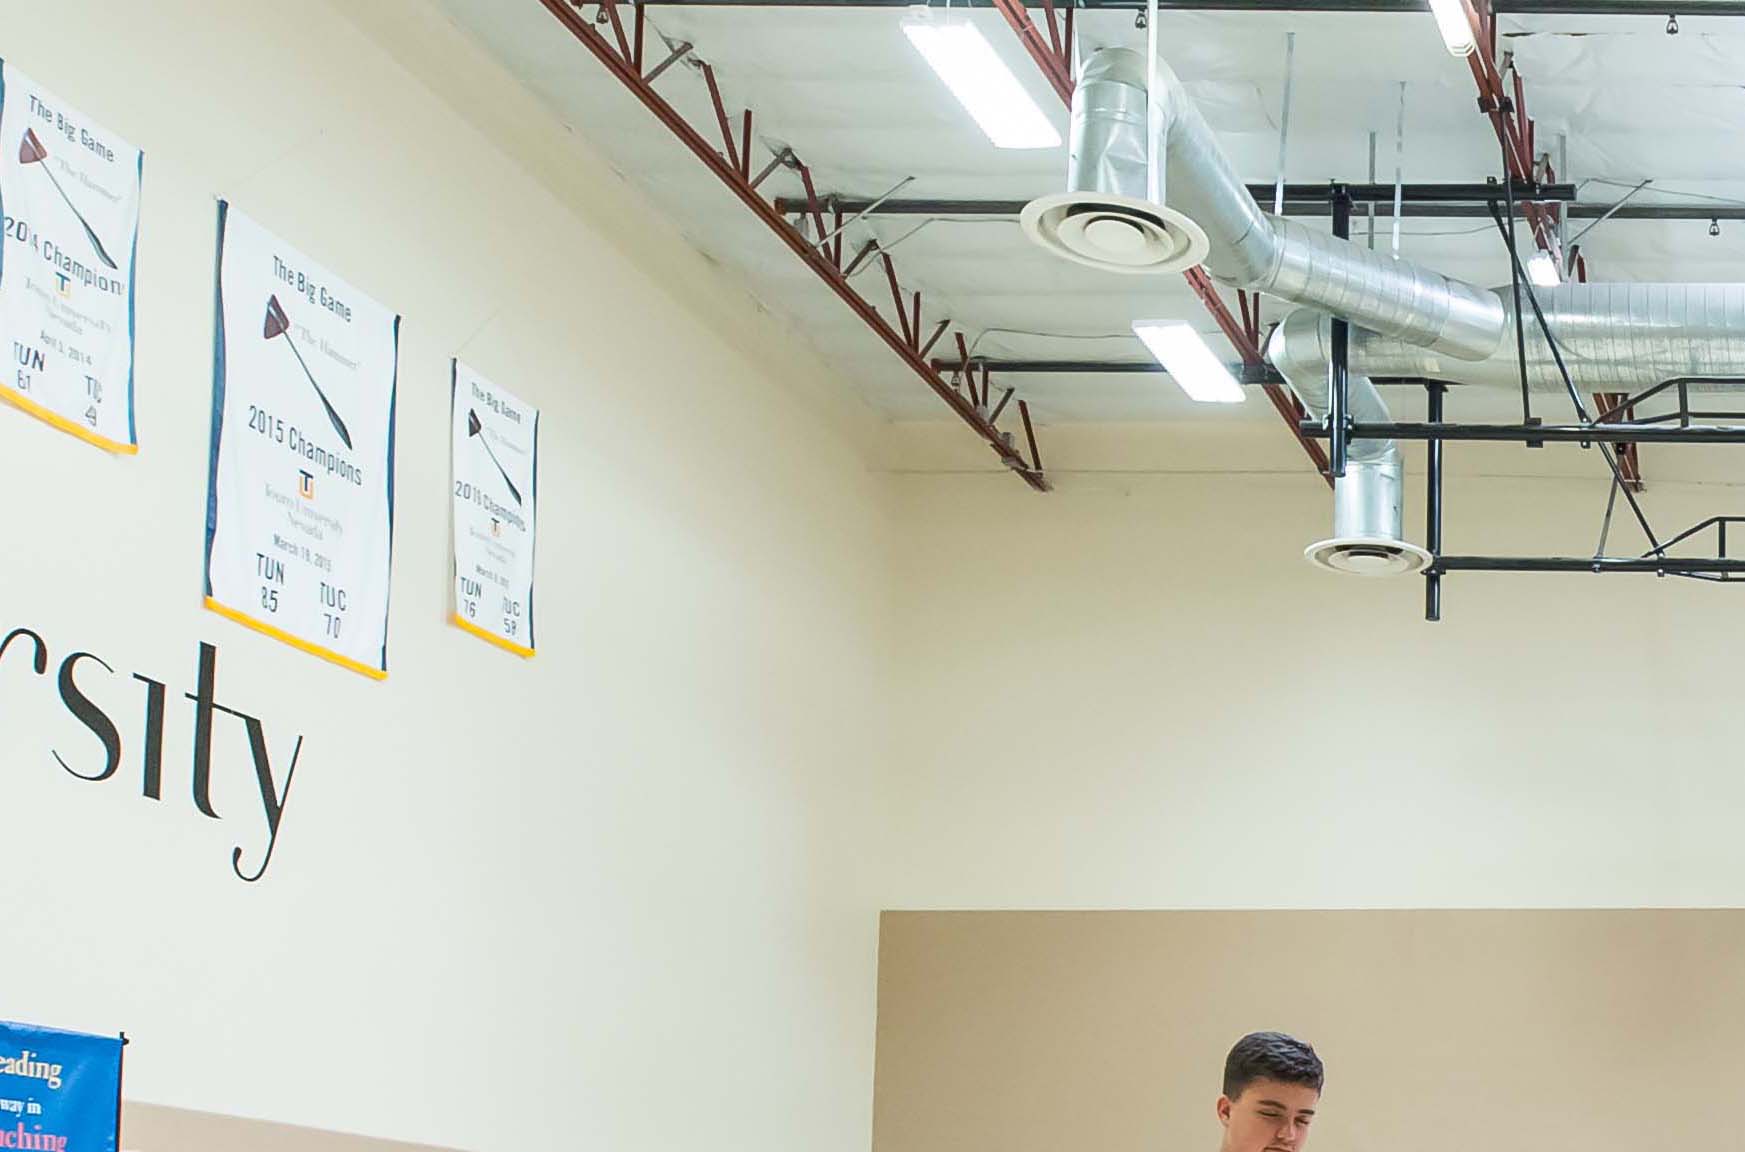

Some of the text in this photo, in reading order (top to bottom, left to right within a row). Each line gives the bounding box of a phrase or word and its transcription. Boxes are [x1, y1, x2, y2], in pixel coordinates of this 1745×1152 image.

[30, 94, 115, 162] The Big Game
[273, 255, 353, 323] The Big Game
[248, 405, 363, 486] 2015 Champions
[256, 552, 286, 586] TUN
[319, 581, 347, 612] TUC
[460, 576, 482, 599] TUN
[323, 613, 342, 639] 70
[27, 1097, 42, 1115] in
